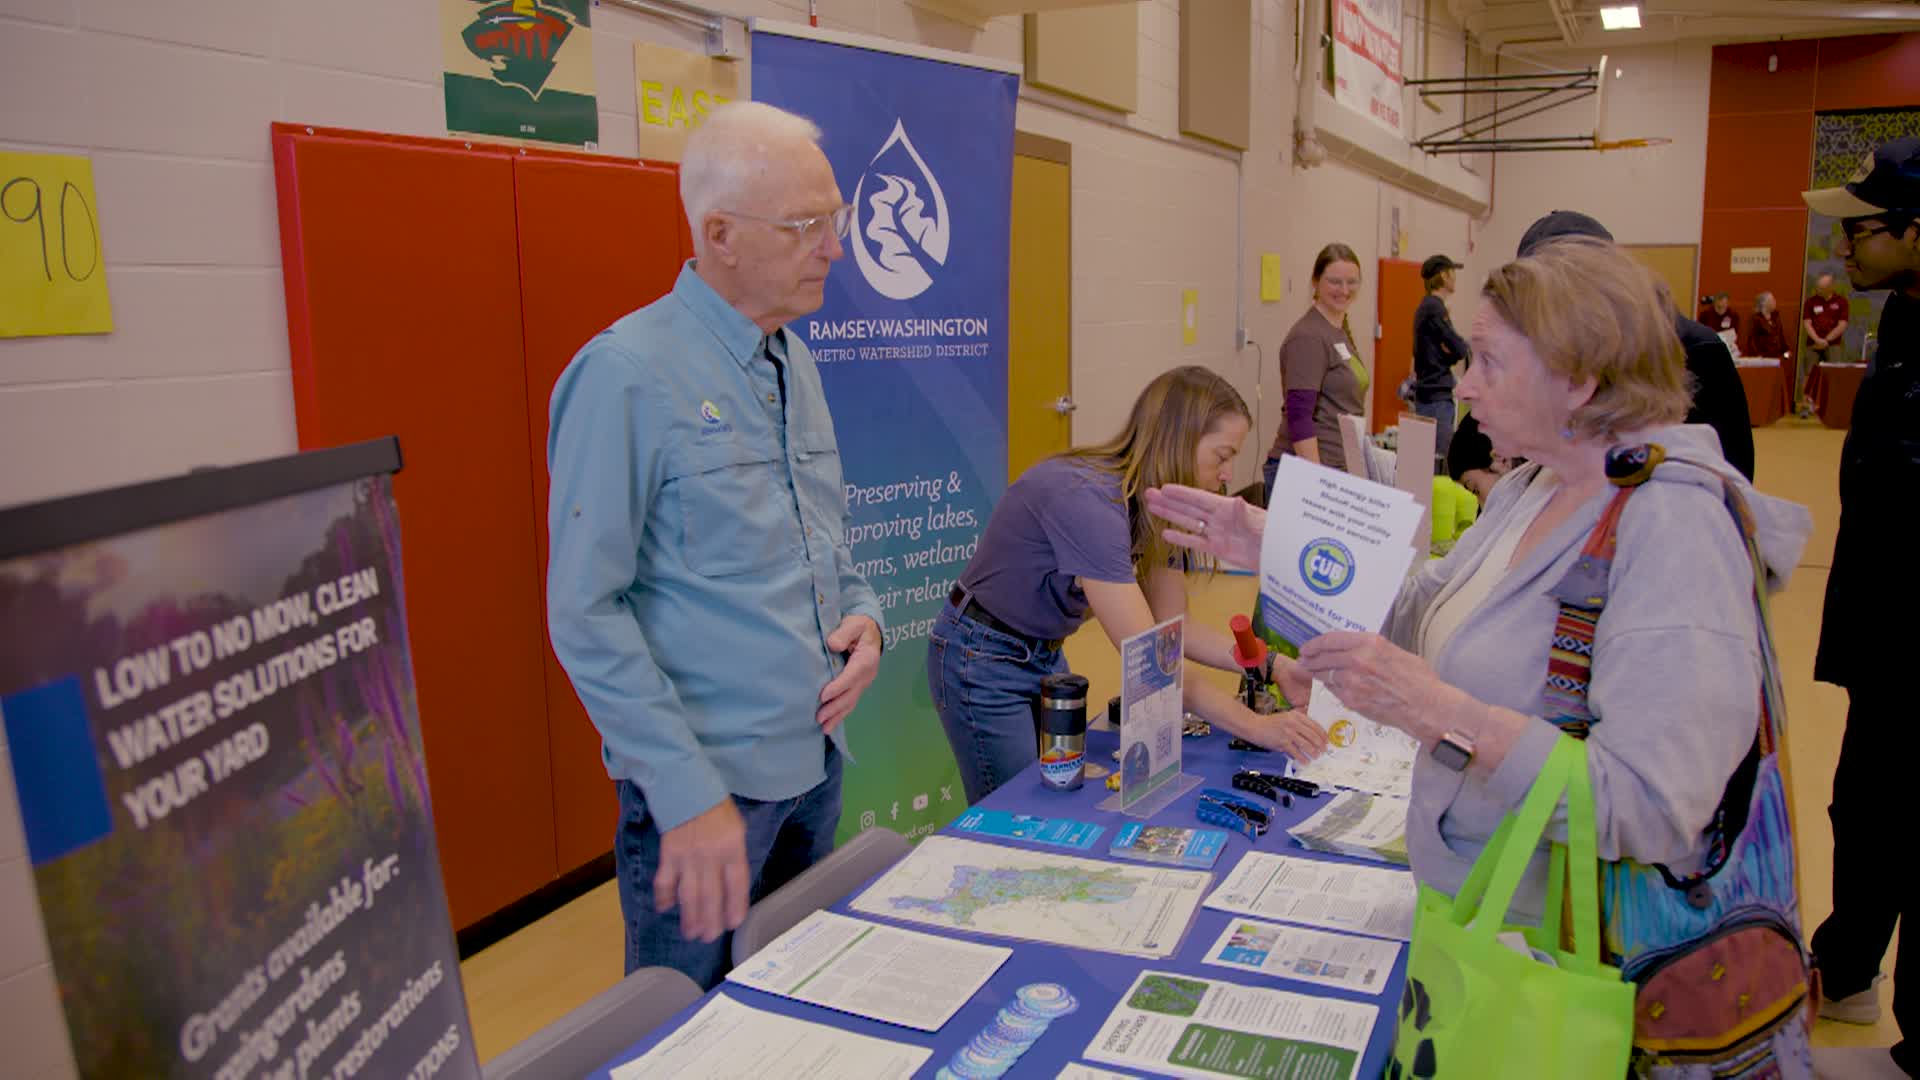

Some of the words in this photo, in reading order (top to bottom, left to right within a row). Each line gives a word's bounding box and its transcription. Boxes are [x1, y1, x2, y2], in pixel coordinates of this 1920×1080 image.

[809, 318, 989, 341] RAMSEY-WASHINGTON
[810, 348, 856, 363] METRO
[859, 344, 932, 361] WATERSHED
[936, 342, 989, 358] DISTRICT
[844, 475, 944, 508] Preserving
[946, 470, 962, 494] &
[927, 504, 979, 532] lakes,
[854, 556, 898, 577] ams,
[903, 534, 980, 569] wetland
[879, 584, 902, 611] eir
[95, 644, 171, 710] LOW
[170, 630, 213, 676] TO
[211, 615, 252, 660] NO
[252, 591, 318, 643] MOW,
[315, 567, 379, 616] CLEAN
[883, 618, 937, 651] syste
[106, 690, 216, 770] WATER
[213, 633, 338, 718] SOLUTIONS
[335, 617, 378, 660] FOR
[122, 756, 209, 831] YOUR
[203, 721, 270, 783] YARD
[180, 963, 268, 1062] Grants
[266, 876, 364, 982] available
[363, 853, 400, 909] for:
